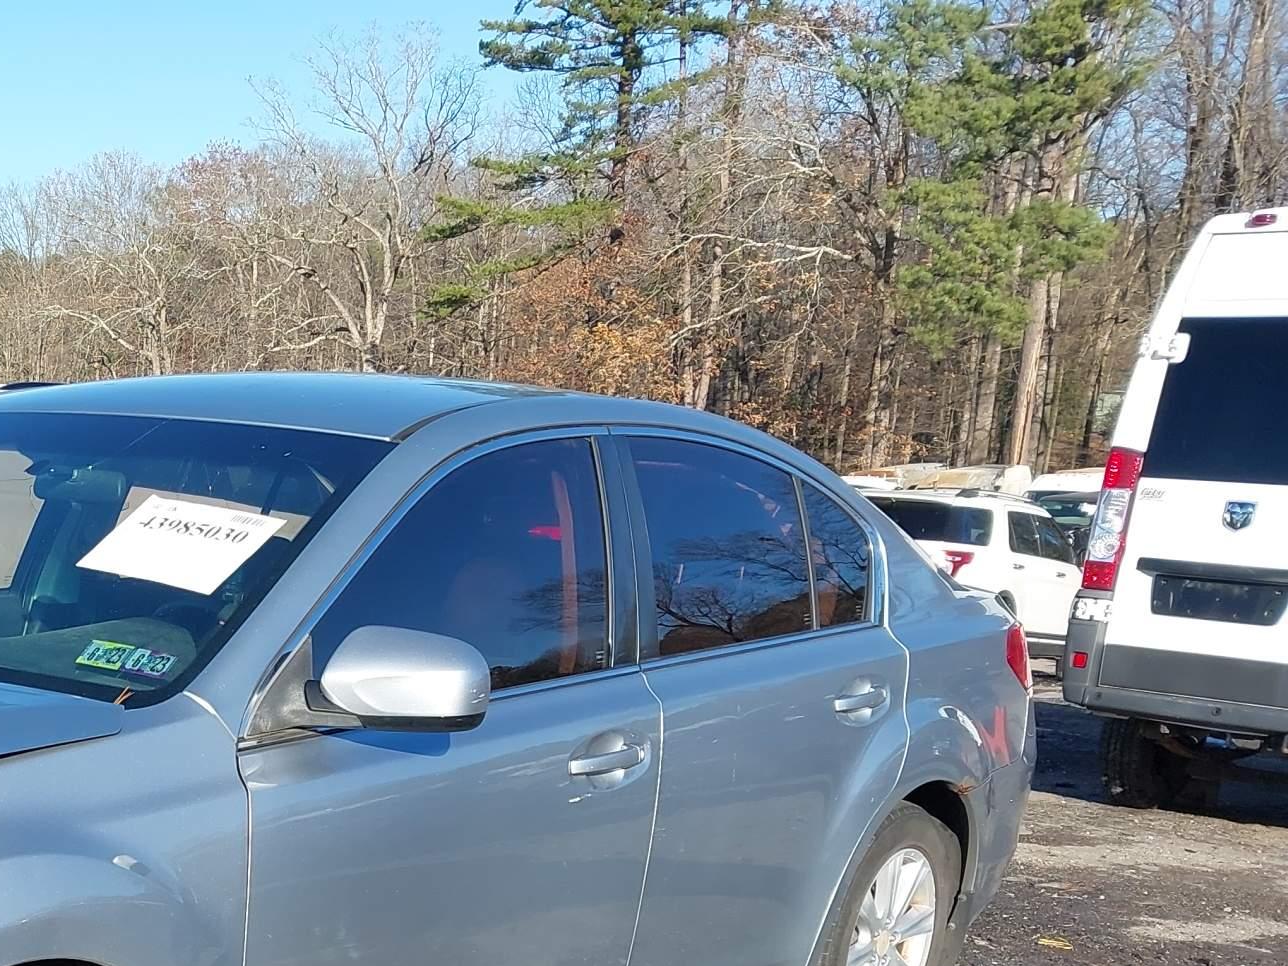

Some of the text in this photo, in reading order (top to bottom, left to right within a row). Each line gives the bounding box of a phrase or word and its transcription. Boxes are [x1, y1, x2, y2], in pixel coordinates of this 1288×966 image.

[138, 515, 249, 544] 43985030
[105, 647, 127, 665] 23
[132, 653, 171, 673] 6 23
